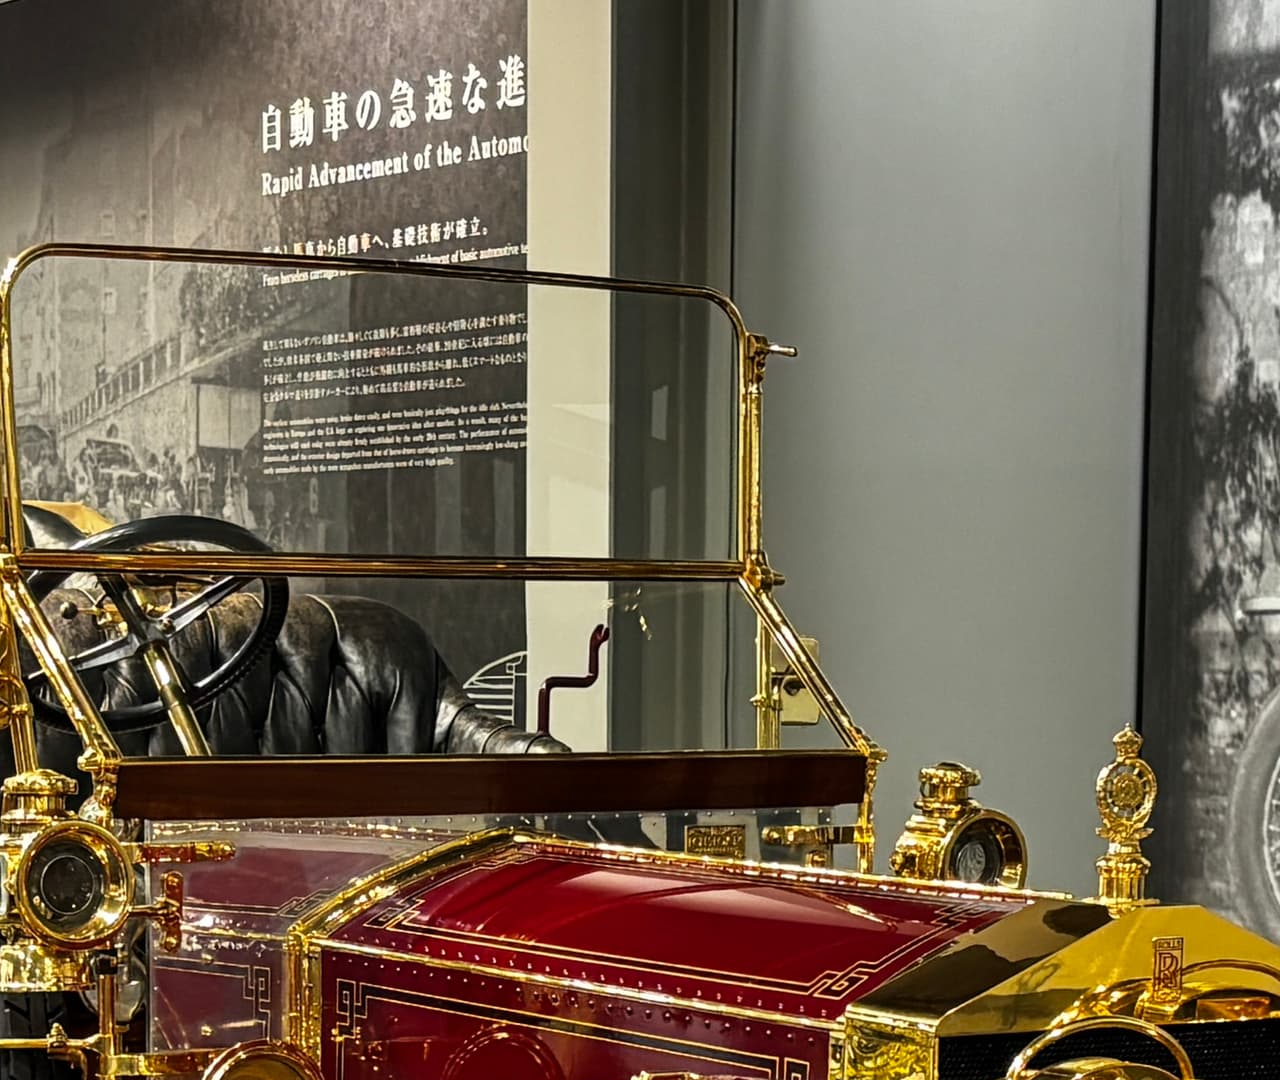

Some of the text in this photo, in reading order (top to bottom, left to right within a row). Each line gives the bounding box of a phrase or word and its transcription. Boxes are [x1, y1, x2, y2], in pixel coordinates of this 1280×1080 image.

[262, 166, 303, 197] Rapid
[308, 152, 409, 188] Advancement
[414, 144, 432, 170] of
[437, 141, 462, 167] the
